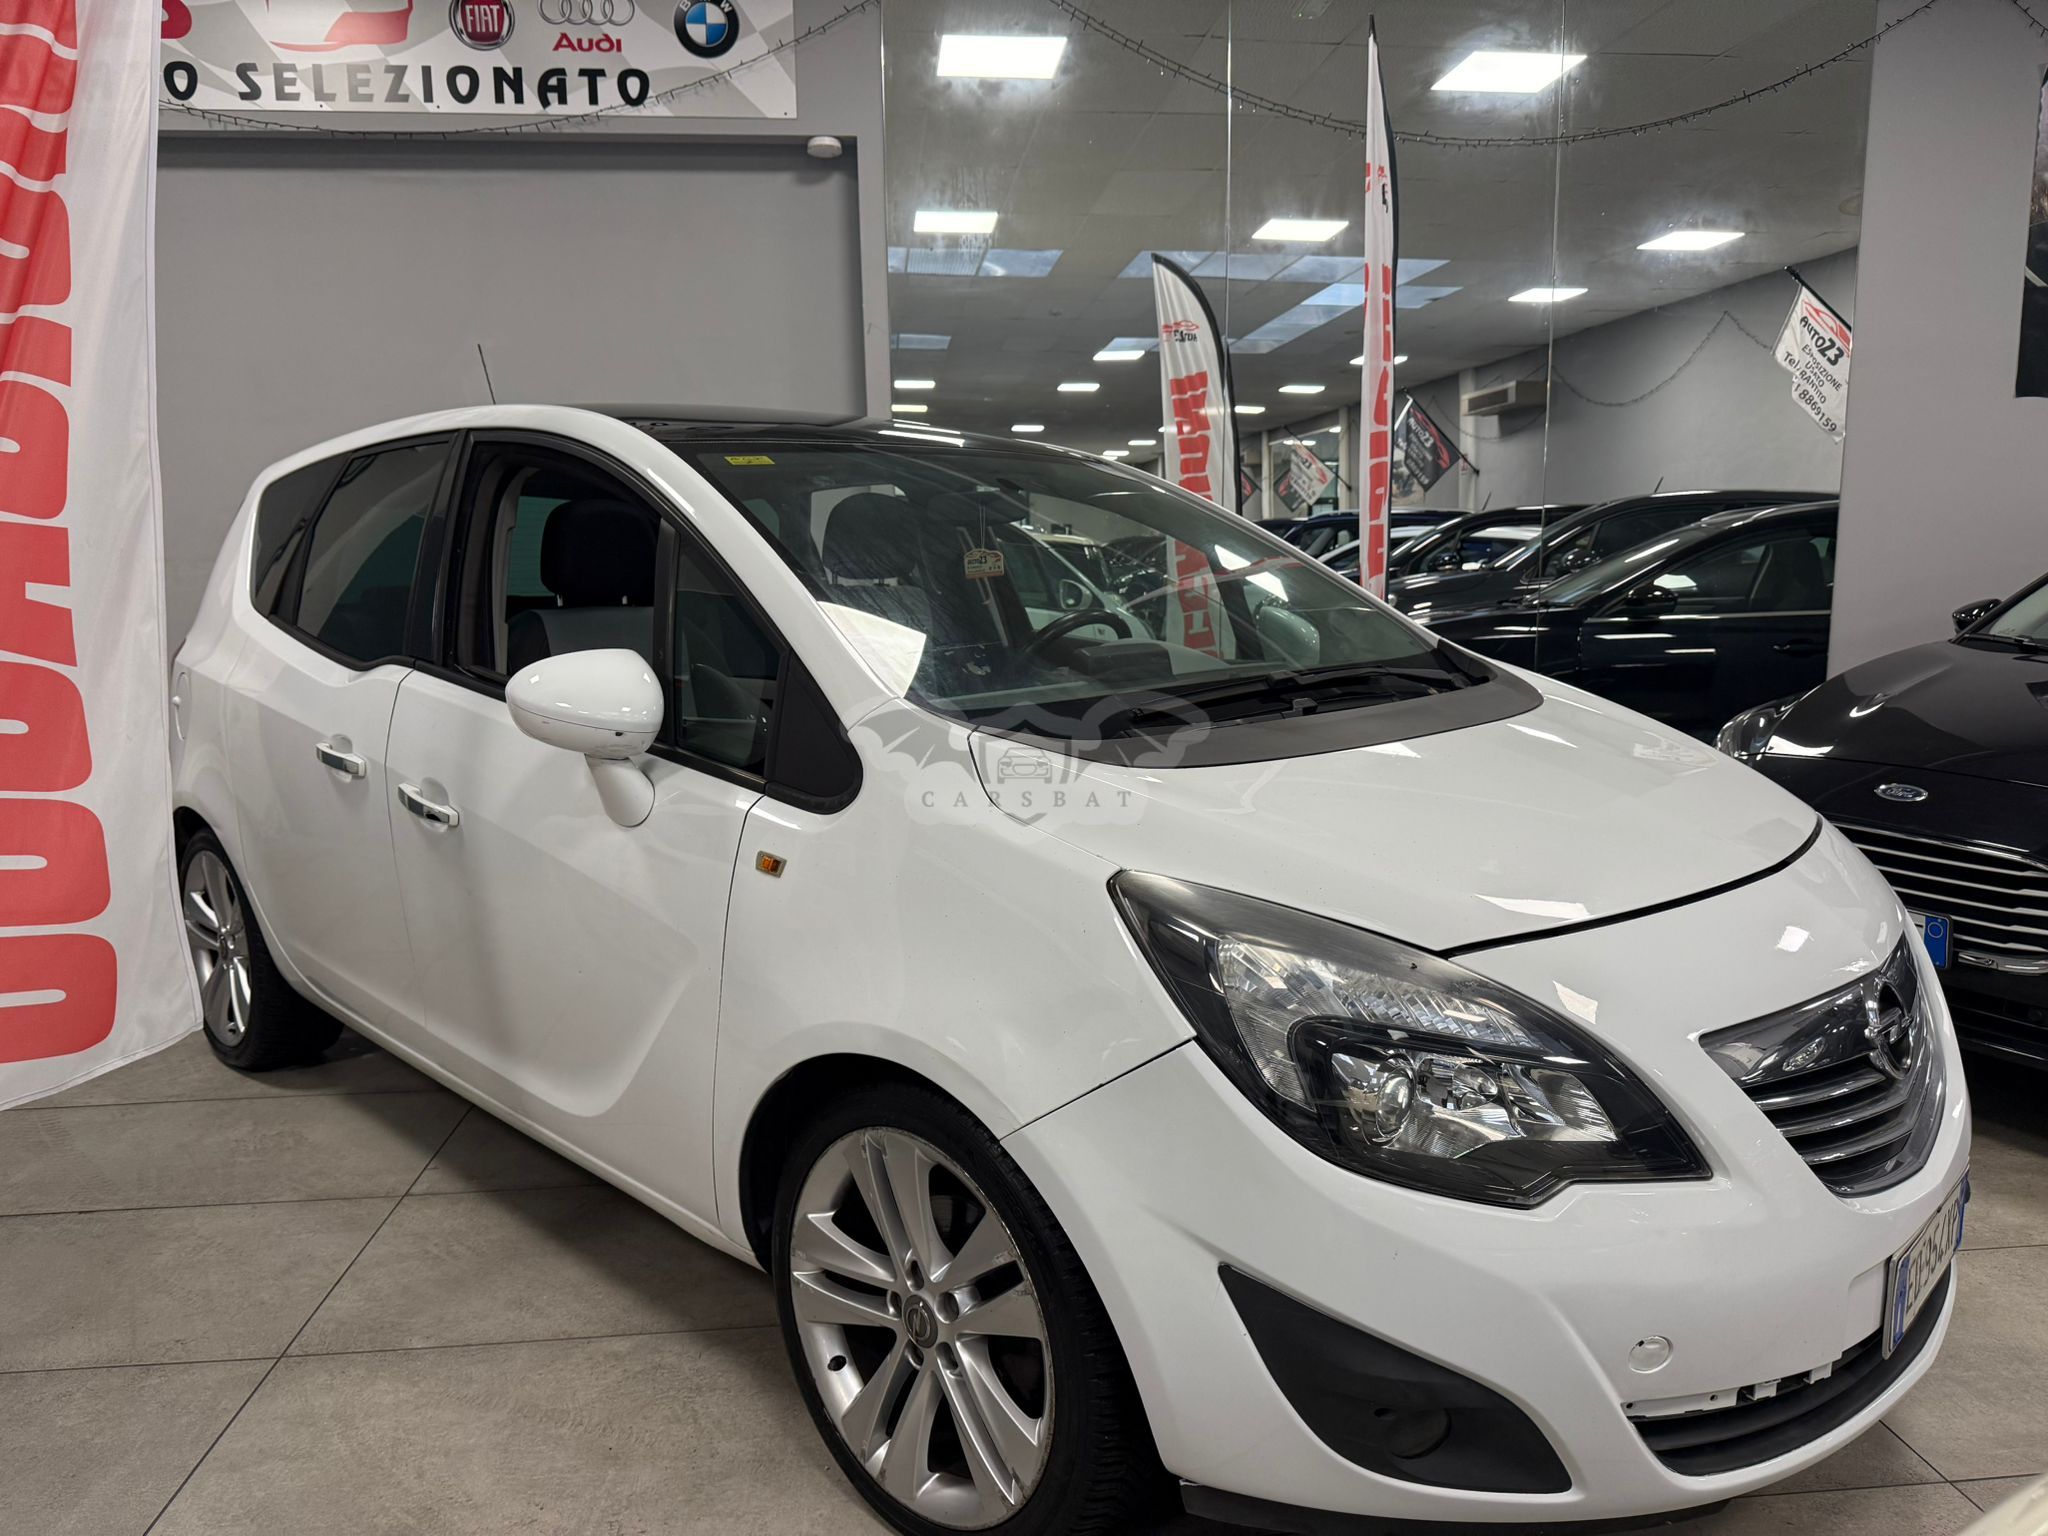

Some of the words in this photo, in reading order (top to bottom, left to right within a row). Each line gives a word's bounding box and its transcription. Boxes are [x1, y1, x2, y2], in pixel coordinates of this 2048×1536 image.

[465, 4, 500, 33] FIAT
[552, 32, 622, 53] Audi
[236, 62, 650, 110] SELEZIONATO
